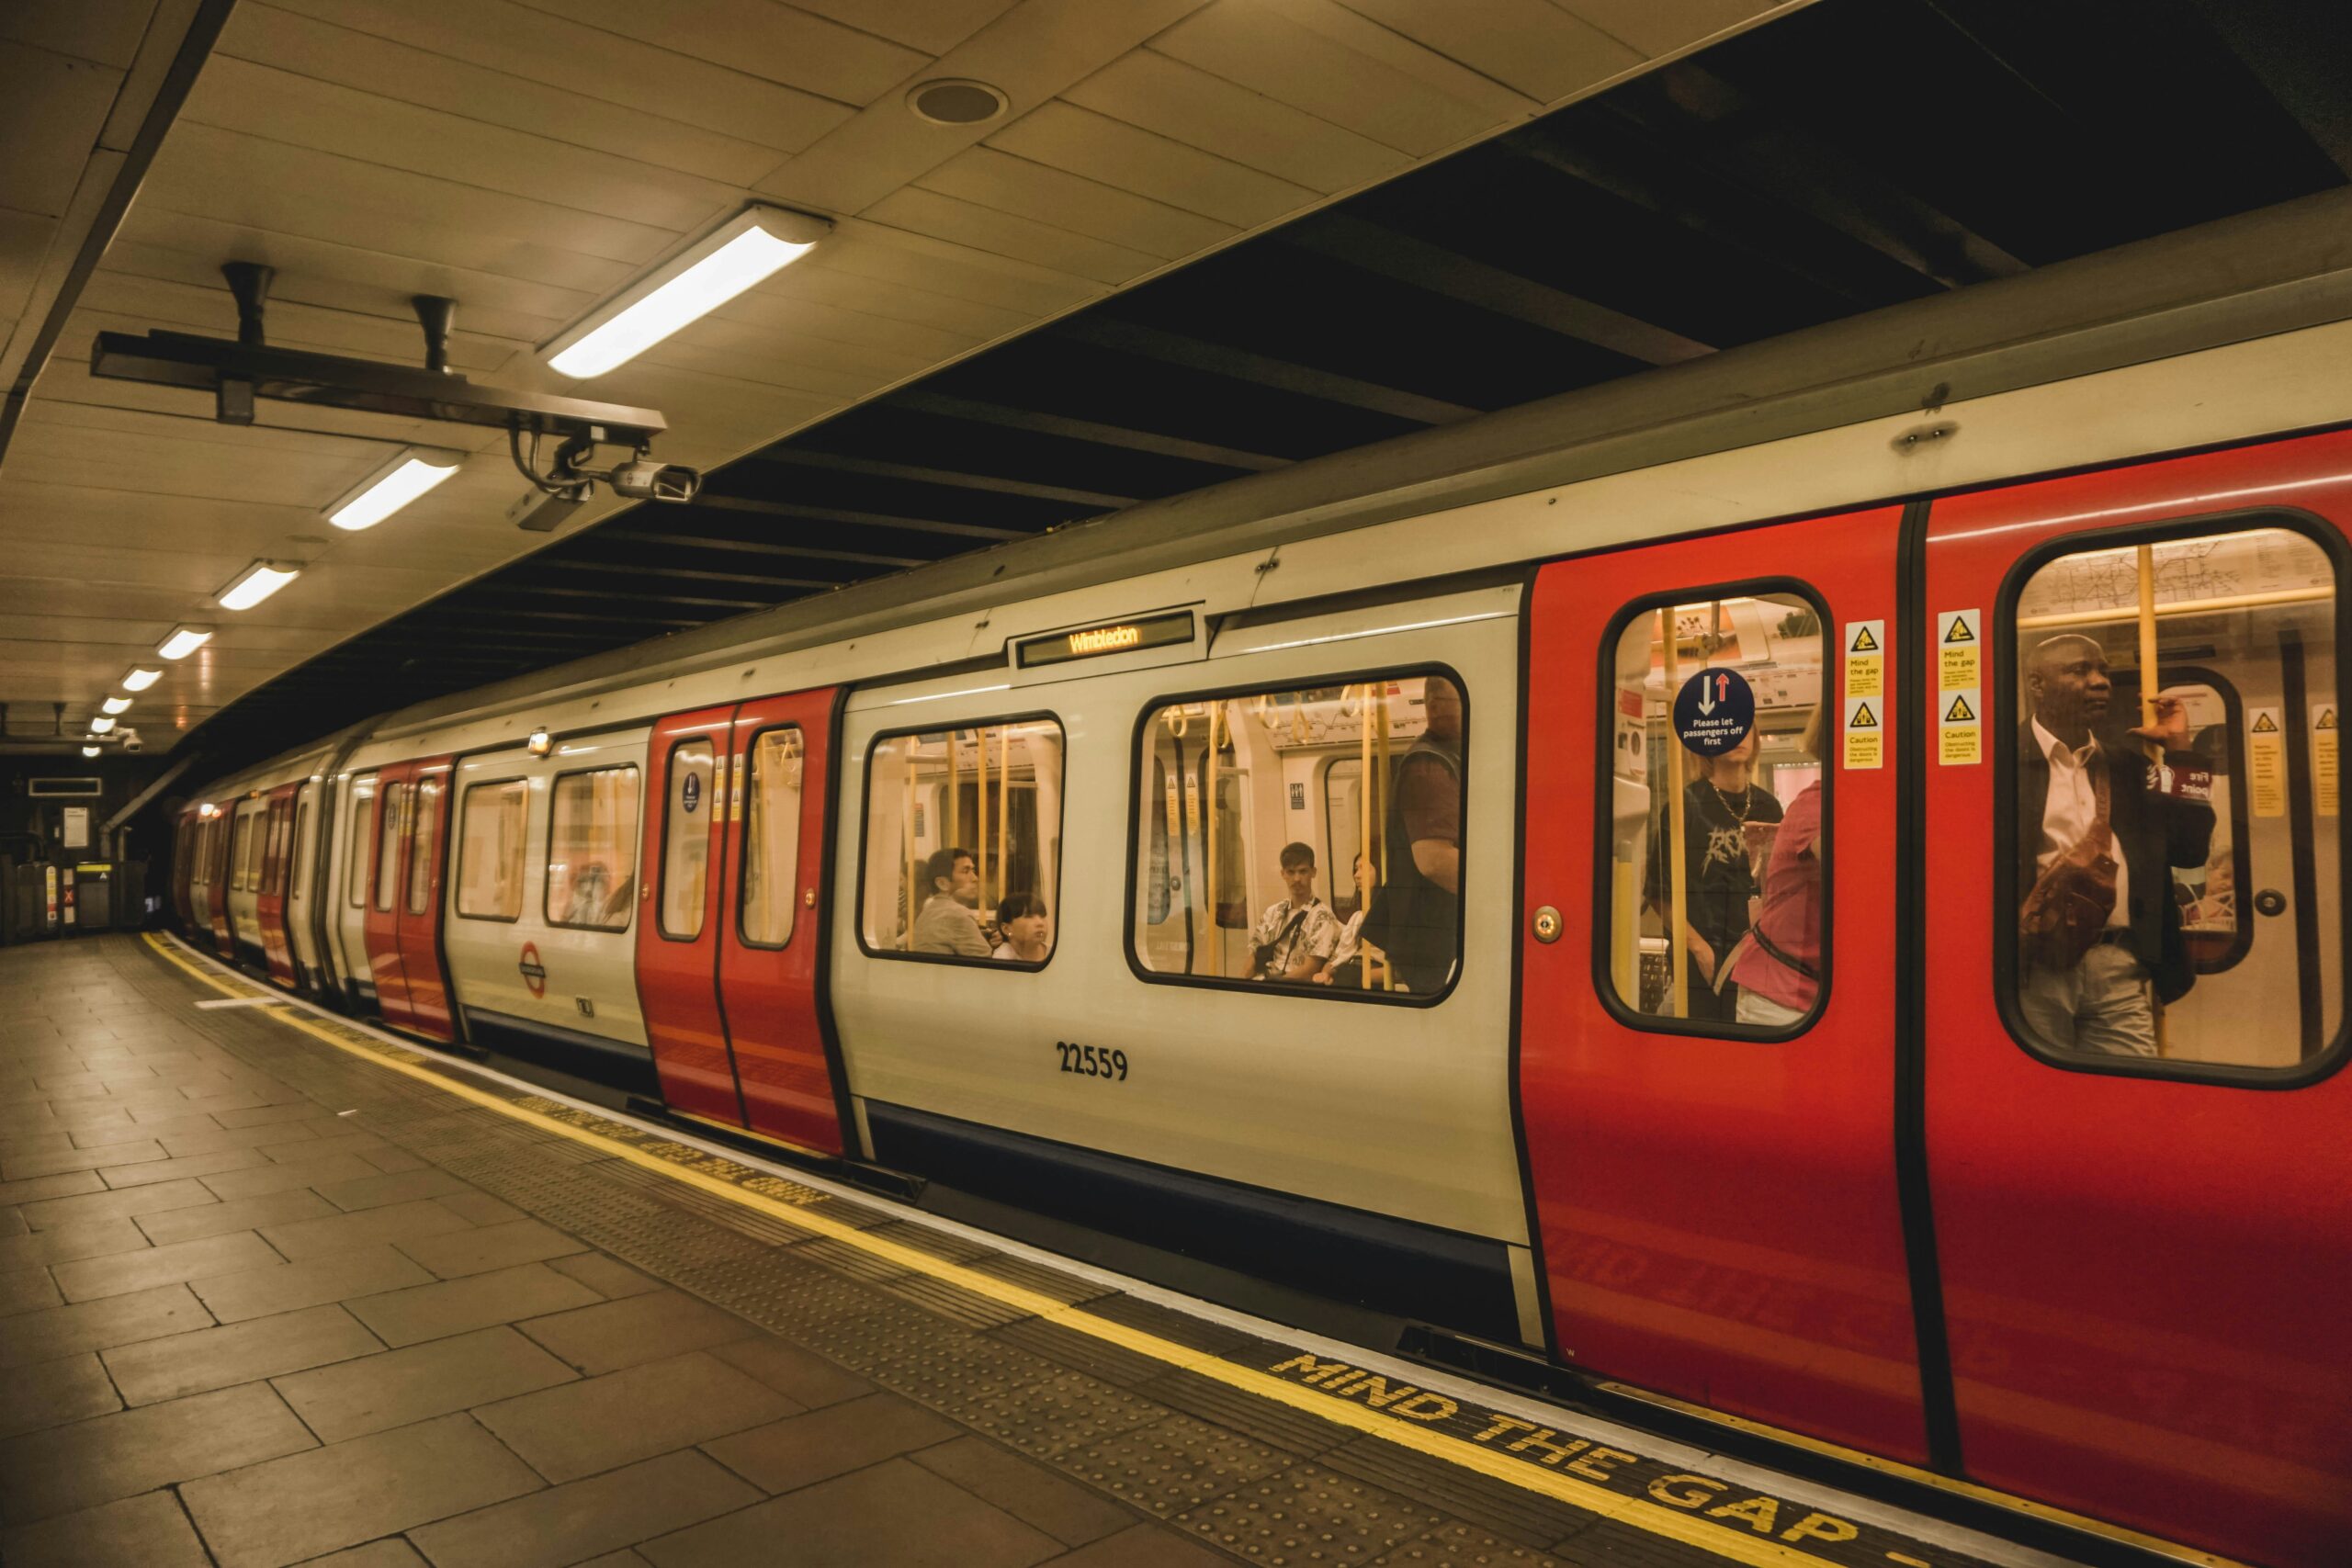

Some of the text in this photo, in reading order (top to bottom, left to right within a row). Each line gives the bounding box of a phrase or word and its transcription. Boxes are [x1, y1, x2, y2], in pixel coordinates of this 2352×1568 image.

[1069, 626, 1138, 653] Wimbledon
[1961, 660, 1975, 668] gap
[1683, 726, 1744, 739] passengers off
[1693, 719, 1719, 728] Please
[1057, 1041, 1127, 1081] 22559
[1269, 1354, 1859, 1542] MIND THE GAP
